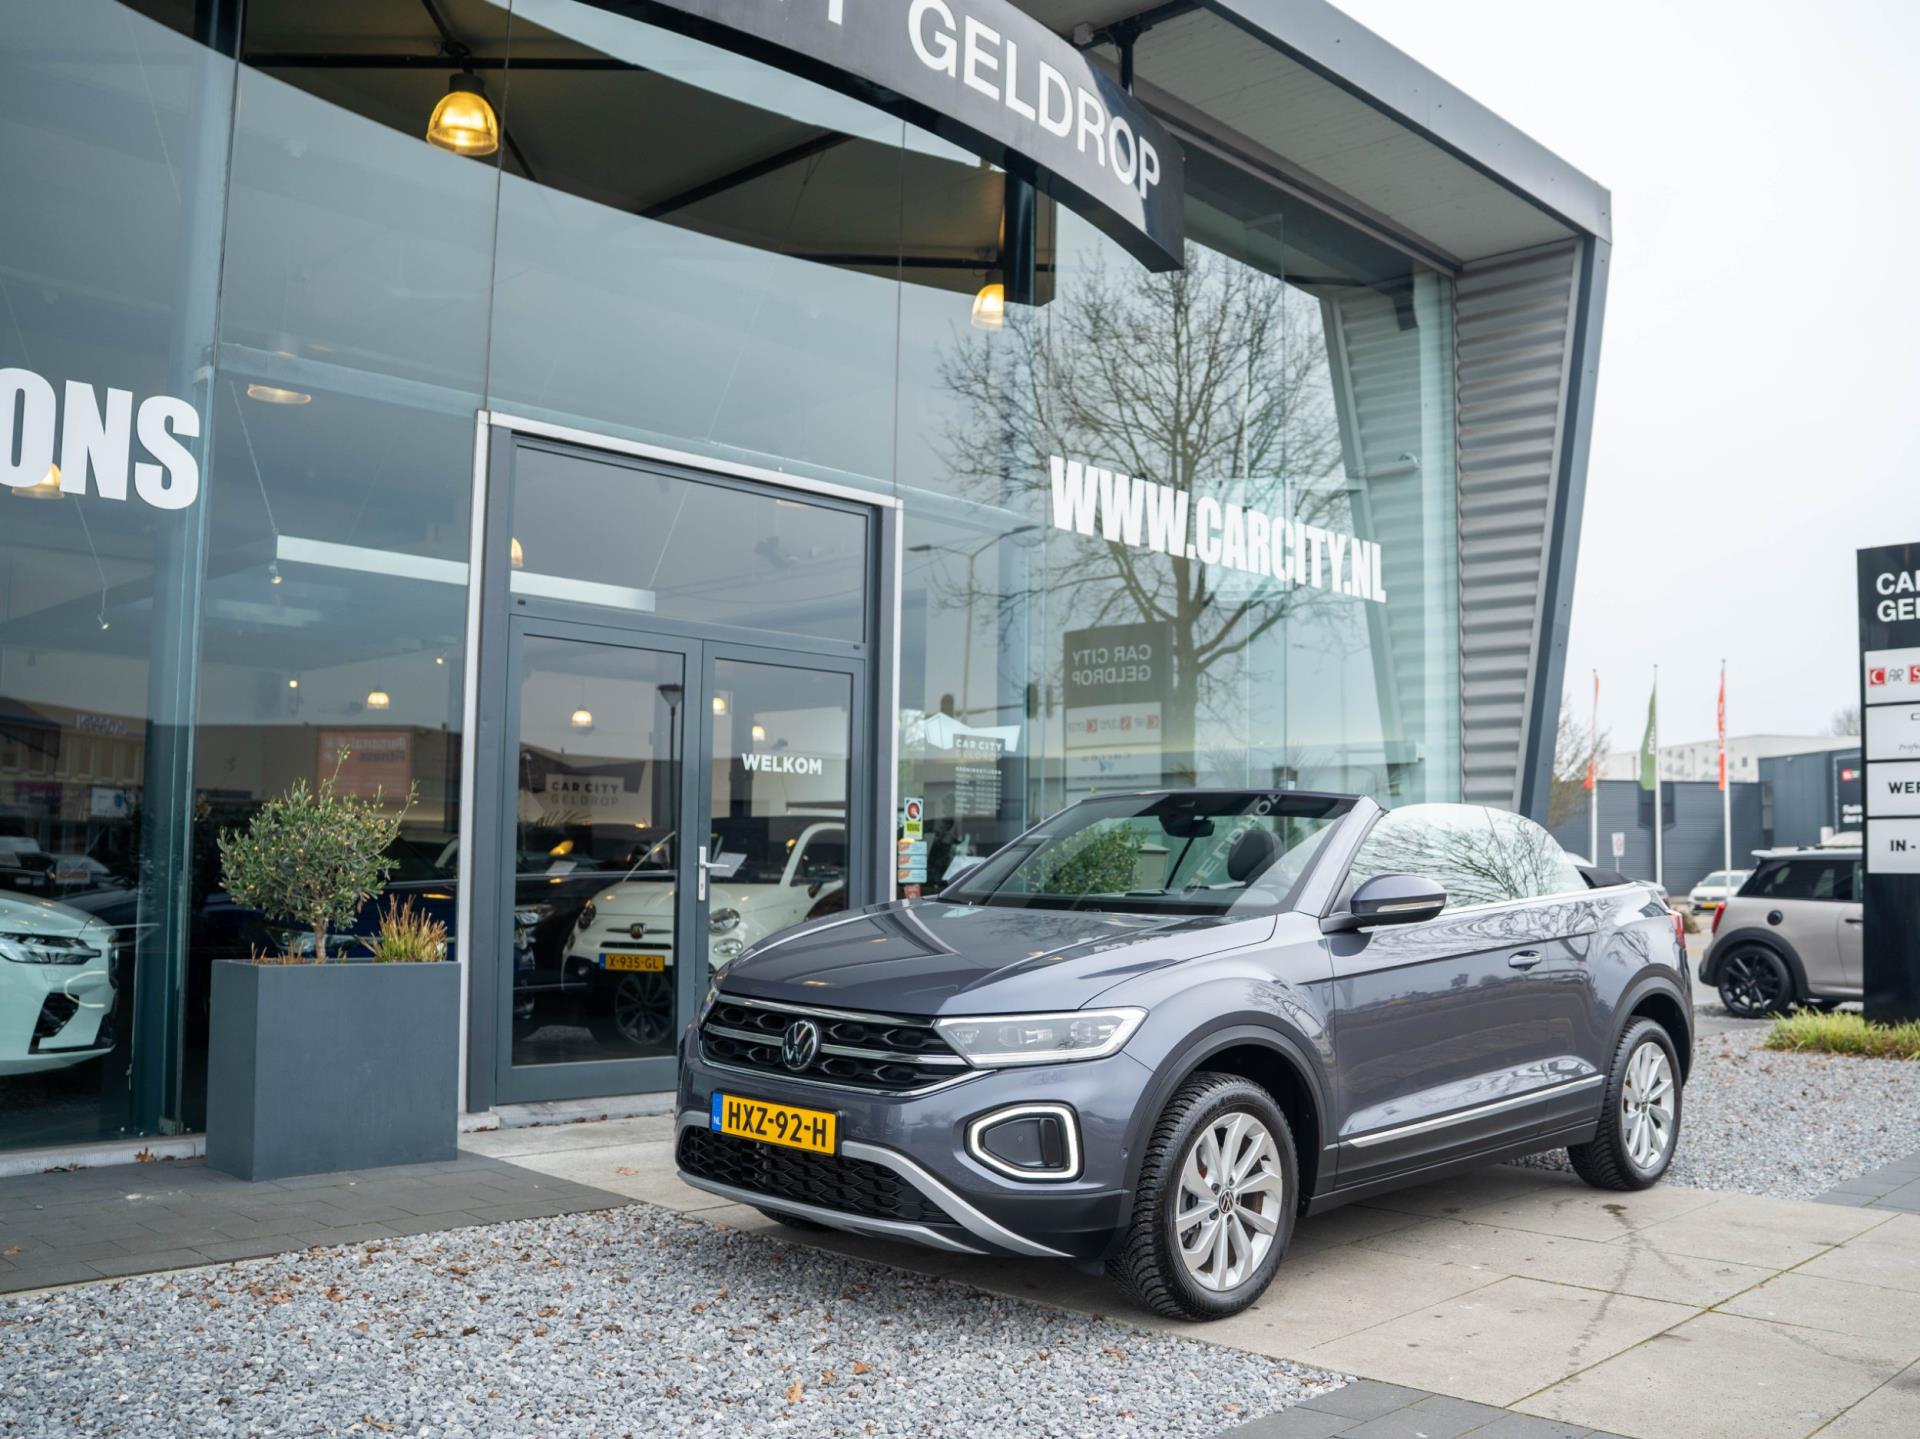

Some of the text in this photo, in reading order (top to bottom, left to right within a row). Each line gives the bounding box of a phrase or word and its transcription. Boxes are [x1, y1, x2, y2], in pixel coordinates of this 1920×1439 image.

[908, 0, 1161, 200] GELDROP
[0, 367, 200, 510] ONS
[1050, 455, 1386, 604] WWW.CARCITY.NL
[741, 753, 823, 775] WELKOM
[551, 781, 619, 794] CAR CITY
[1888, 781, 1920, 794] WE
[1890, 839, 1906, 852] IN
[728, 1101, 827, 1148] HXZ-92-H
